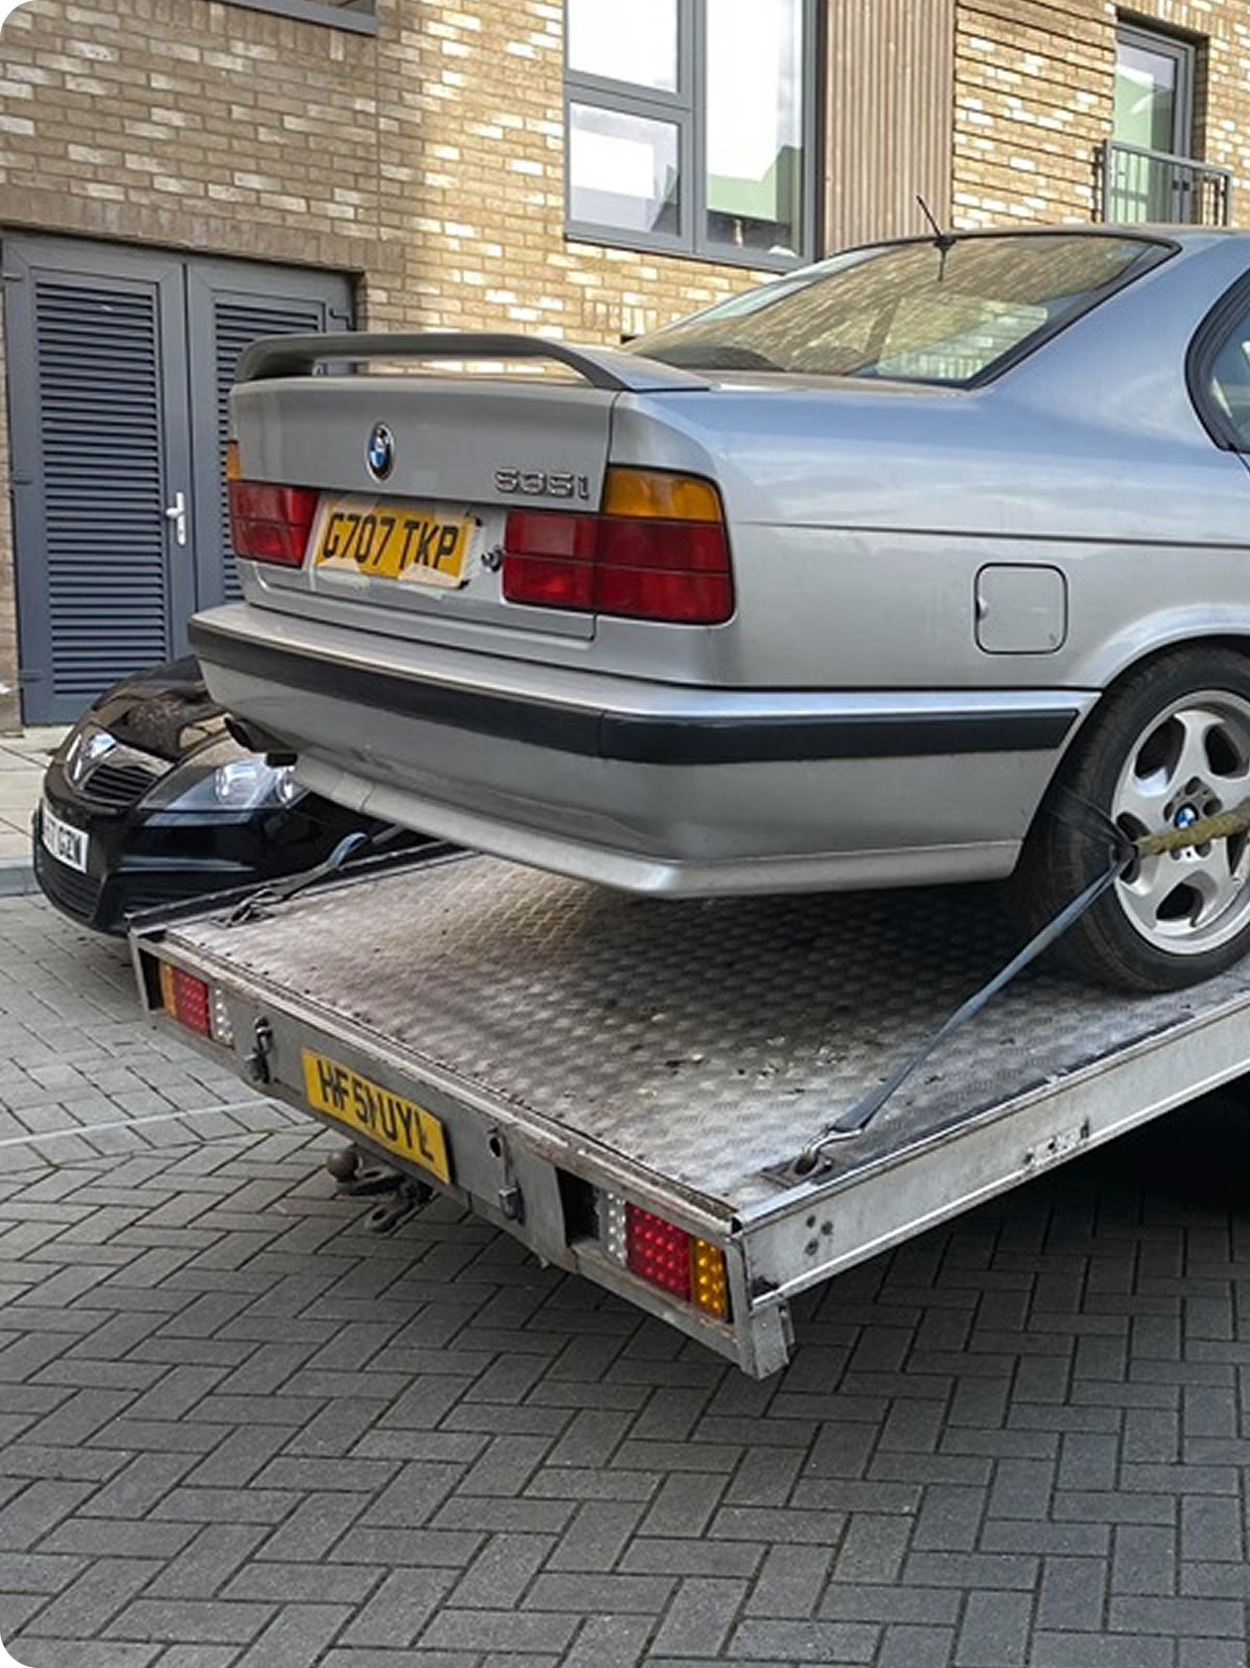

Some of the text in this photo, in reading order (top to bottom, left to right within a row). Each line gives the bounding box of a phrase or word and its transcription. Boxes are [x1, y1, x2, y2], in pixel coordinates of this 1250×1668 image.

[495, 467, 589, 500] 535i
[323, 512, 459, 570] G707 TKP
